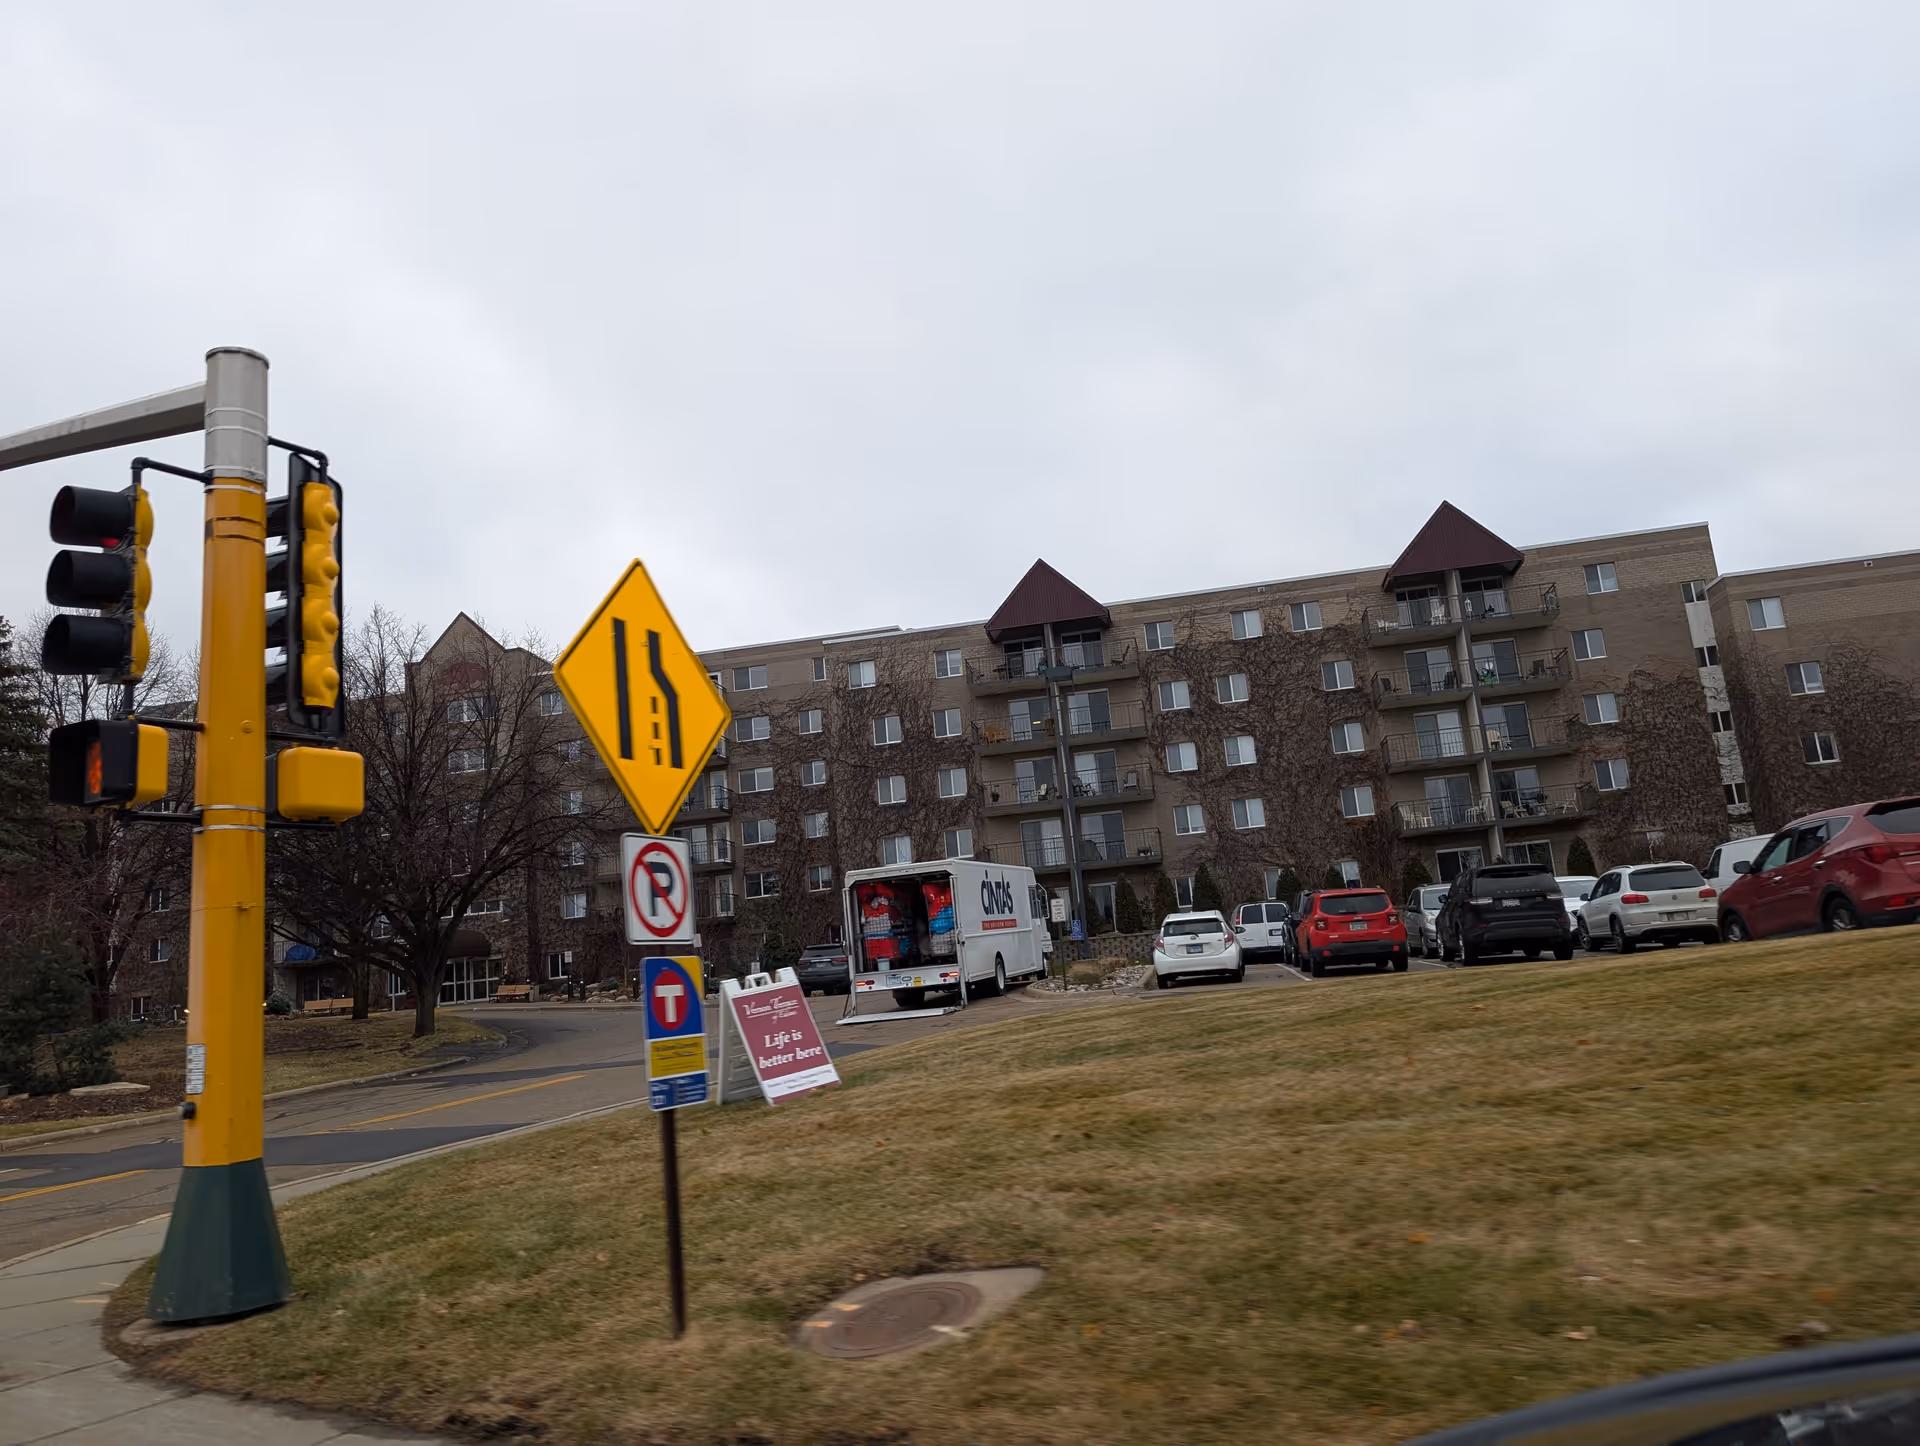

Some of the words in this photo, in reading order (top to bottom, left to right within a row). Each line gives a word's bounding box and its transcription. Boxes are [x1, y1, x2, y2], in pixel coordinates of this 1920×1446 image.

[646, 861, 673, 917] P
[655, 984, 684, 1022] T
[764, 1031, 791, 1049] Life
[790, 1029, 803, 1041] is
[758, 1053, 795, 1069] better
[795, 1046, 823, 1060] here
